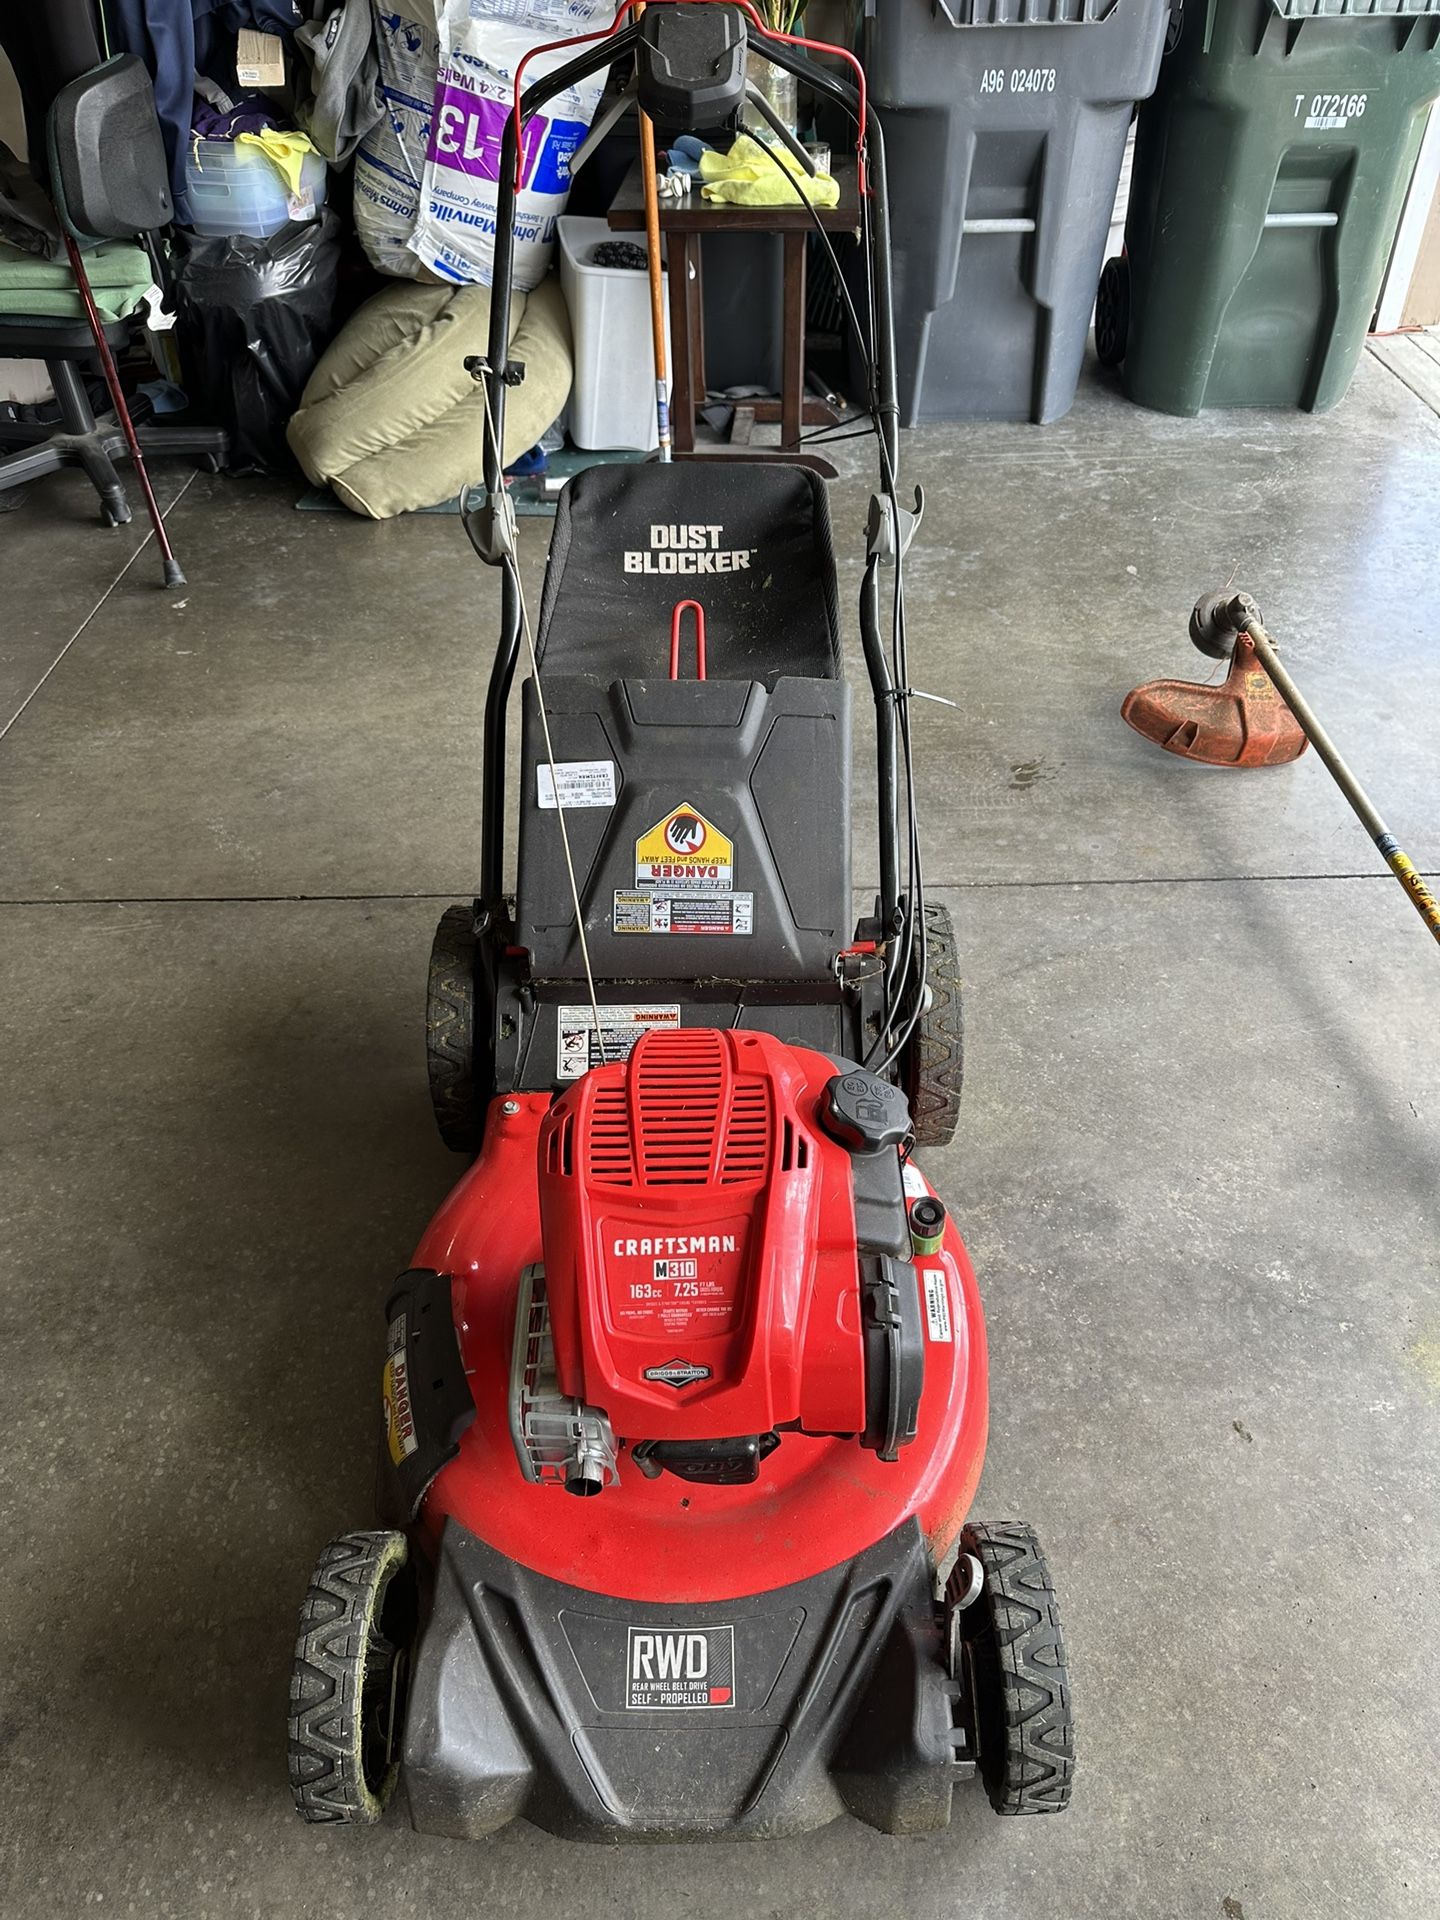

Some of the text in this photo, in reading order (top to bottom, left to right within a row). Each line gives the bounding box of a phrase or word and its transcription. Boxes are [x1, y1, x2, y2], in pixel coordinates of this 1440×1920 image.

[437, 66, 475, 91] Walls
[980, 69, 1056, 92] A96 024078
[1294, 94, 1368, 117] T 072166
[380, 194, 416, 220] Johns
[432, 185, 469, 208] Company
[513, 226, 541, 243] John
[650, 525, 724, 549] DUST
[624, 551, 751, 574] BLOCKER
[641, 855, 728, 865] KEEP HANDS and FEET AWAY
[650, 864, 719, 879] DANGER
[634, 1013, 670, 1021] WARNING
[614, 1235, 735, 1256] CRAFTSMAN
[655, 1261, 696, 1278] M310
[629, 1284, 662, 1299] 163cc
[673, 1282, 699, 1297] 7.25
[928, 1289, 936, 1318] WARNING
[395, 1363, 413, 1438] DANGER
[633, 1635, 707, 1679] RWD
[632, 1681, 708, 1691] REAR WHEEL BELT DRIVE
[631, 1693, 652, 1705] SELF
[660, 1692, 708, 1704] PROPELLED
